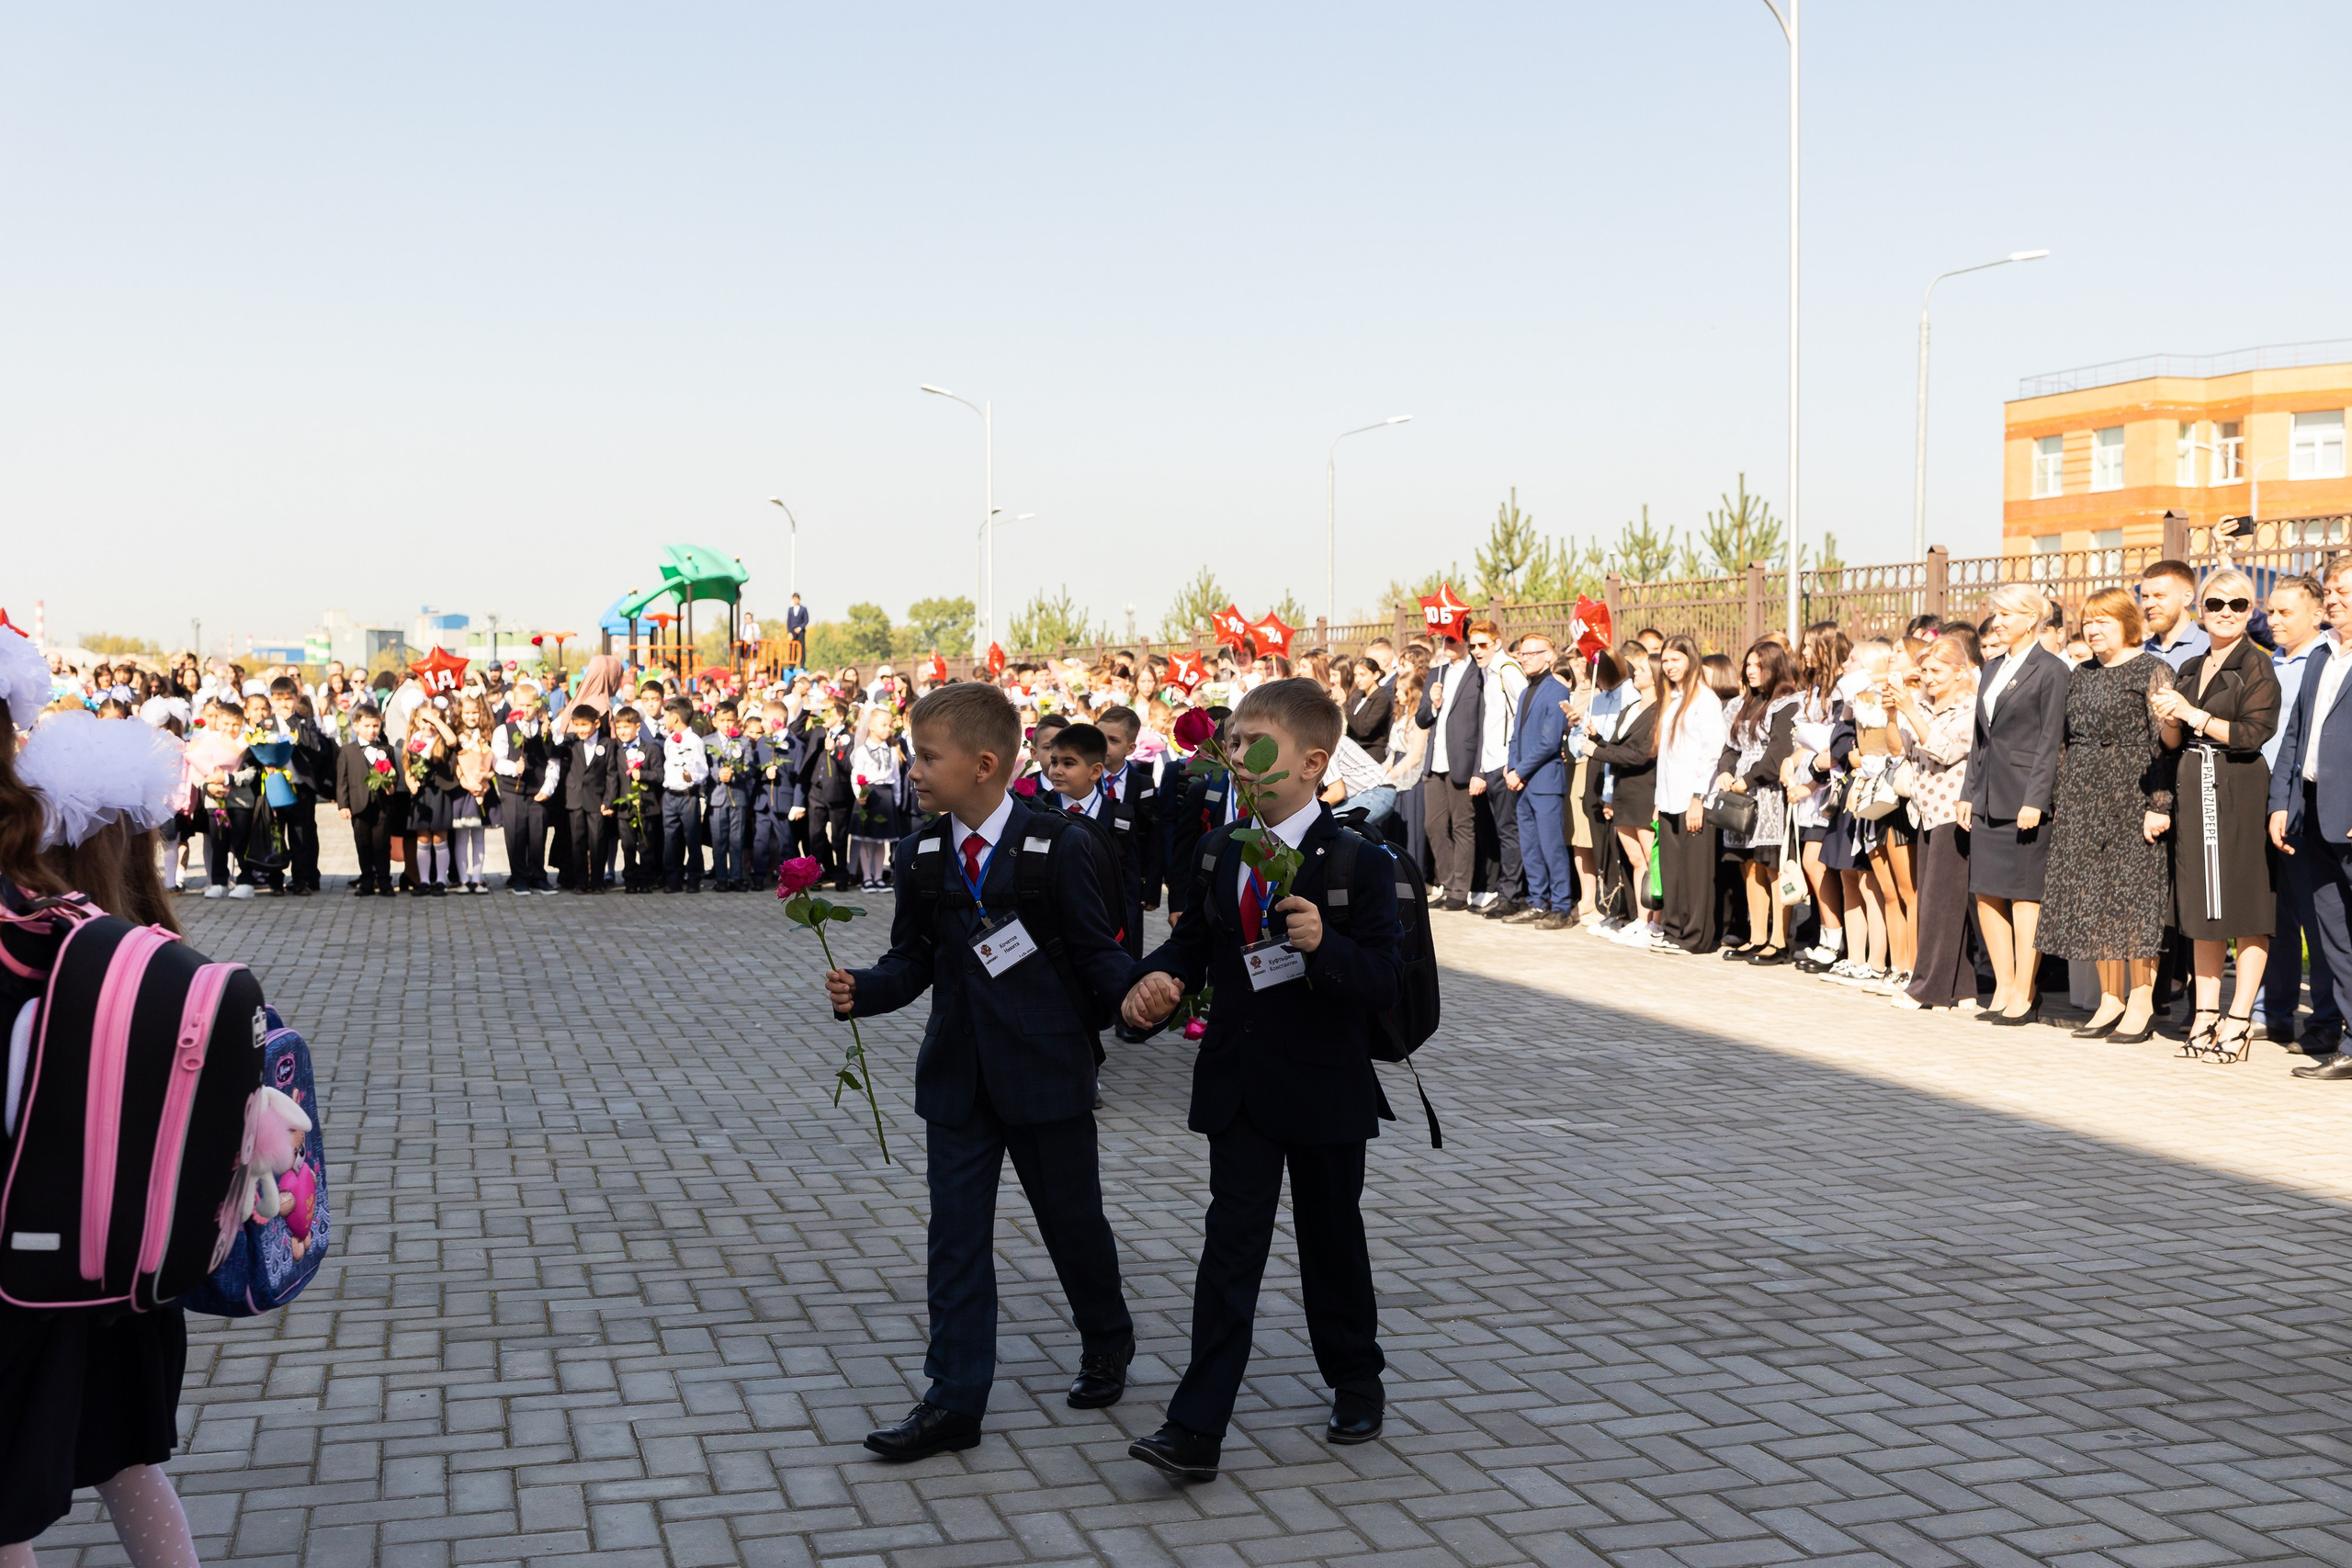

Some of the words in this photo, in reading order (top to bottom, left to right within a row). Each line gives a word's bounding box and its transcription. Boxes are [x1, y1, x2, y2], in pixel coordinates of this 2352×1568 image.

[1424, 605, 1453, 624] 10Б
[1227, 616, 1245, 634] 9Б
[1266, 626, 1283, 644] 9А
[424, 669, 456, 691] 1Д
[999, 935, 1018, 949] Кочетов
[1003, 942, 1021, 954] Никита
[1270, 960, 1298, 972] Константин
